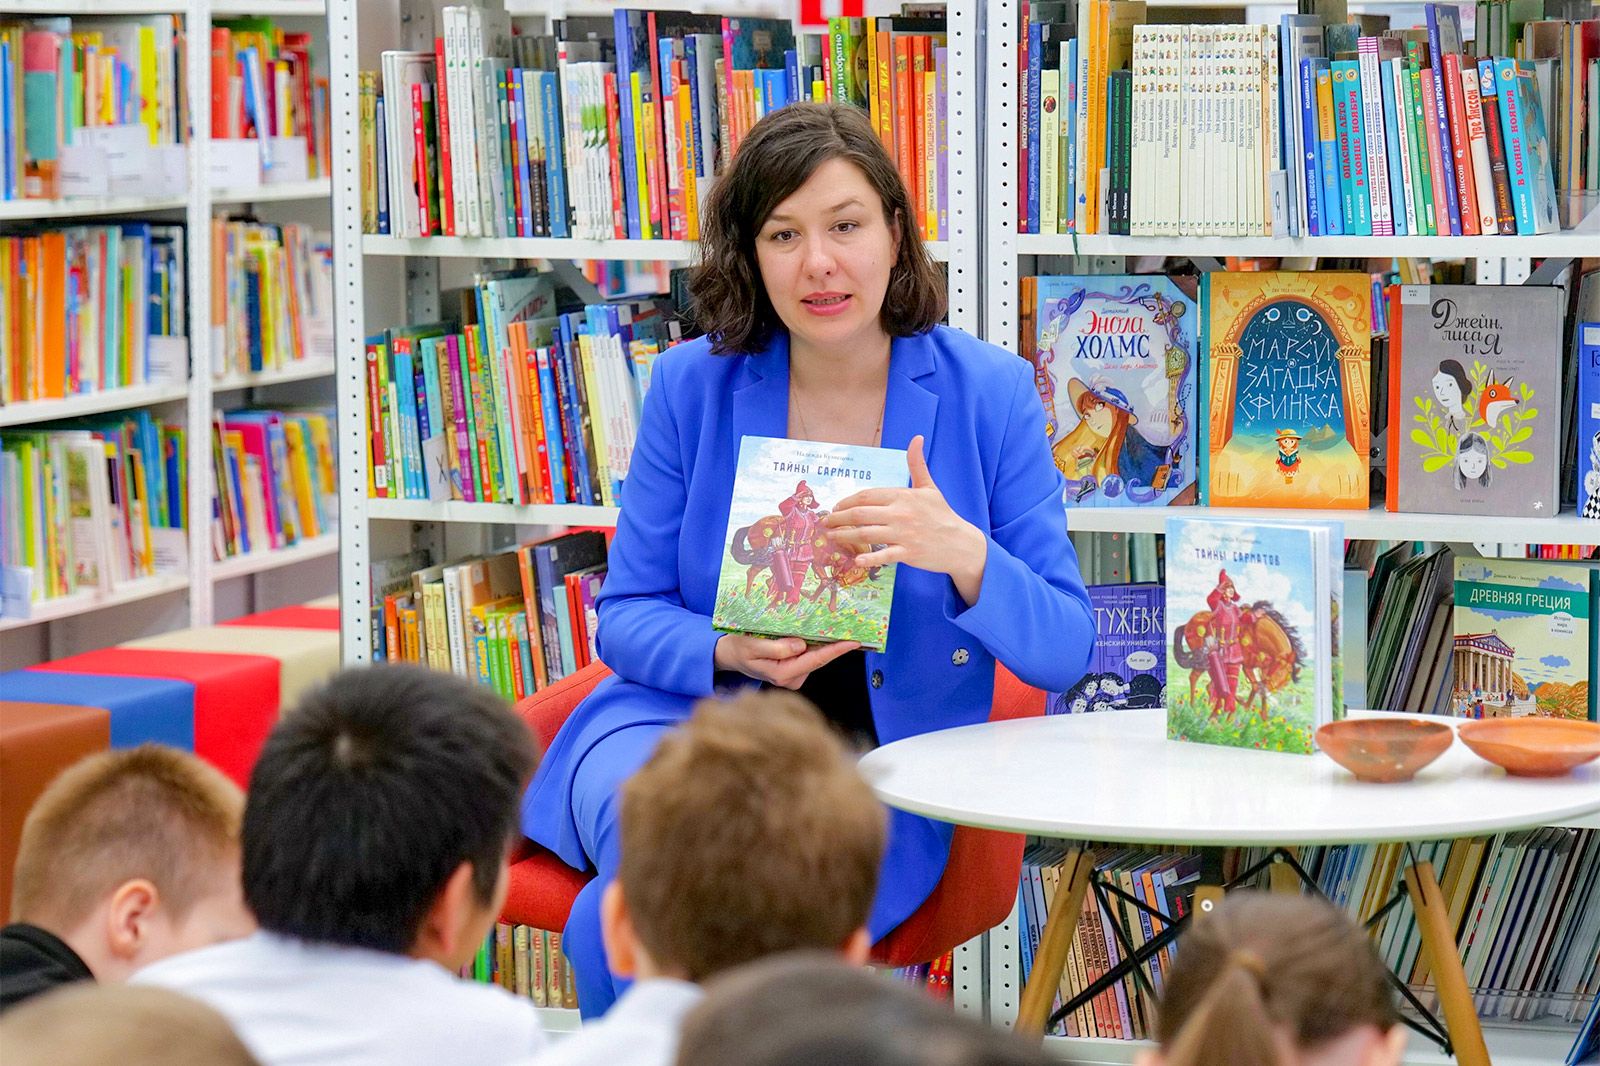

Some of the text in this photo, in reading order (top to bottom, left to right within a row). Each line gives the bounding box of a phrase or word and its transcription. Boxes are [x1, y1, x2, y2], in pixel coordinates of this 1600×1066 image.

[1028, 56, 1039, 135] ЗЛАТОВЛАСКА
[1079, 58, 1088, 119] Златовласка
[1338, 101, 1351, 180] ОПАСНОЕ ЛЕТО
[1349, 90, 1364, 187] В КОНЦЕ НОЯБРЯ
[1469, 122, 1485, 141] Туве
[1506, 89, 1525, 187] В КОНЦЕ НОЯБРЯ
[1457, 164, 1470, 216] Туве Янссон
[1080, 310, 1147, 335] Энола
[1442, 329, 1483, 342] лиса
[1075, 334, 1150, 359] ХОЛМС
[1246, 337, 1331, 363] МАРСИ
[1242, 362, 1337, 394] ЗАГАДКА
[1239, 393, 1342, 420] СФИНКСА
[773, 461, 872, 481] ТАЙНЫ САРМАТОВ
[1195, 546, 1280, 566] ТАЙНЫ САРМАТОВ
[1470, 588, 1571, 611] ДРЕВНЯЯ ГРЕЦИЯ
